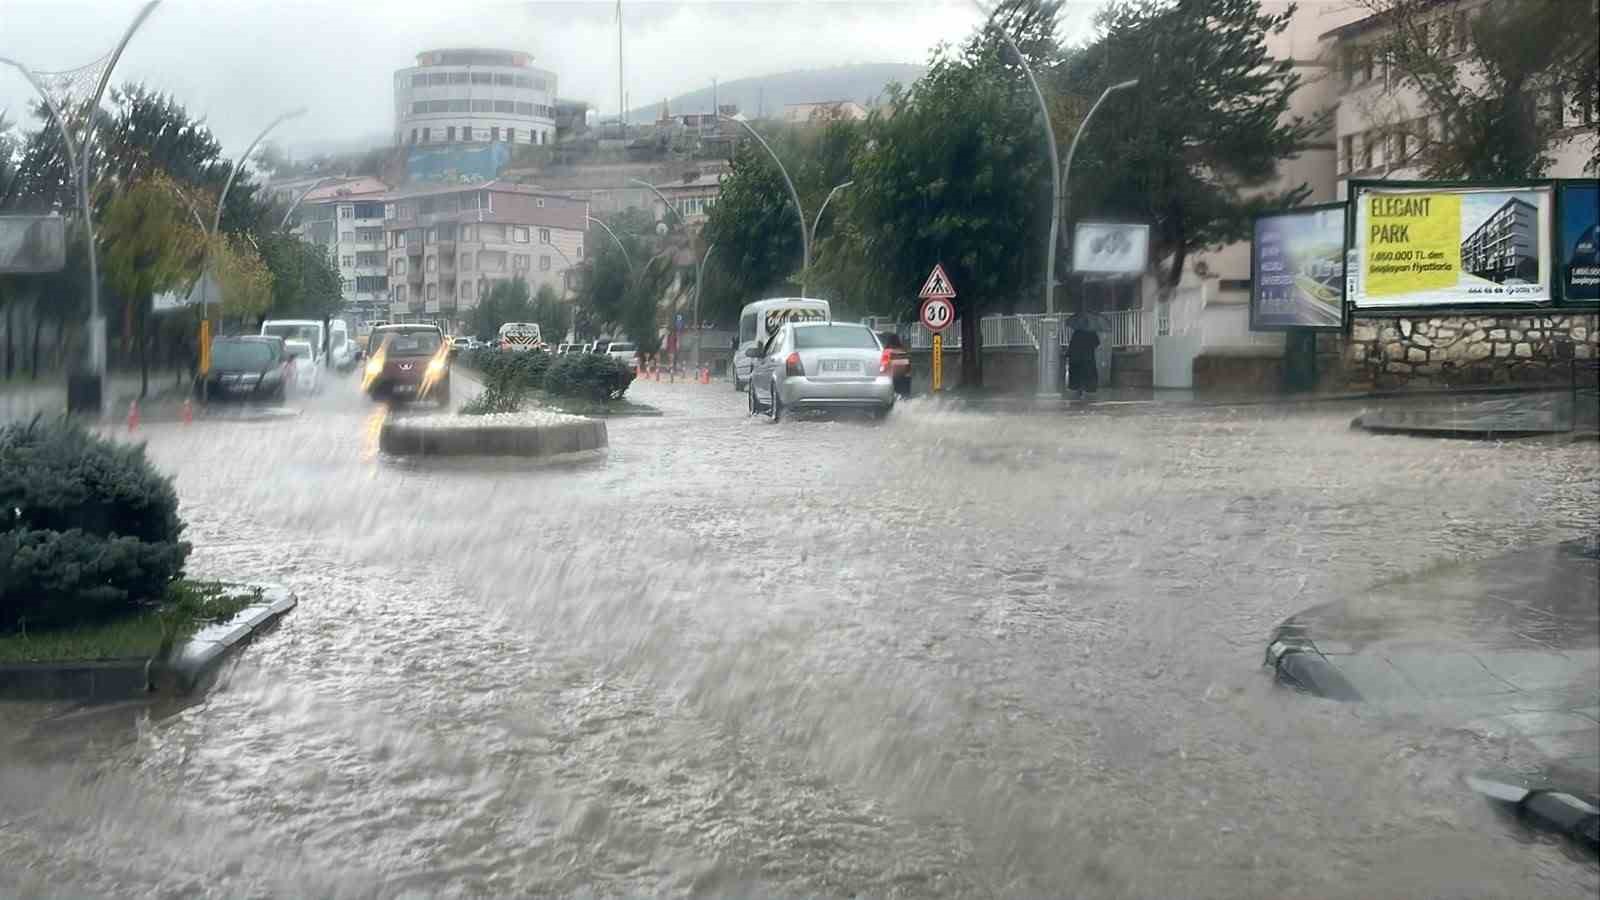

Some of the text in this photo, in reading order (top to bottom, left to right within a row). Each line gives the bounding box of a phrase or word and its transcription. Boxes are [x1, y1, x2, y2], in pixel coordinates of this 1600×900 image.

[1371, 197, 1431, 217] ELEGANT
[1370, 224, 1409, 243] PARK
[927, 305, 947, 321] 30
